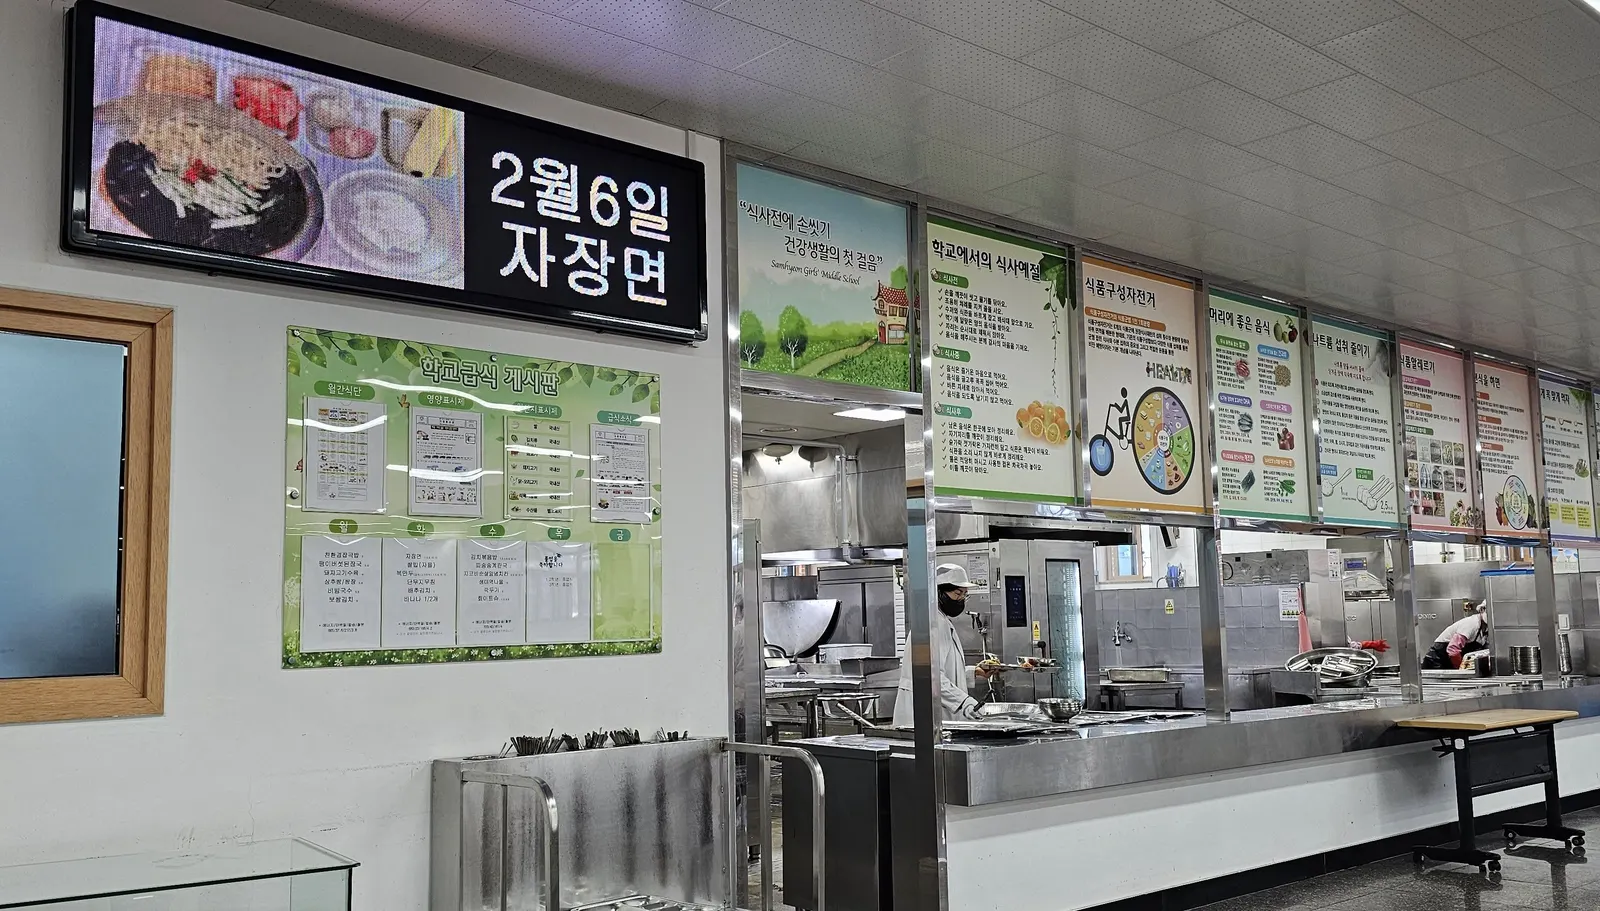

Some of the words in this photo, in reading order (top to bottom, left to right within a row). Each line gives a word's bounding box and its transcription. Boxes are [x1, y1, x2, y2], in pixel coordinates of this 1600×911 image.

[491, 151, 670, 242] 2월6일
[796, 217, 830, 239] 손씻기
[784, 236, 840, 263] 건강생활의
[843, 249, 853, 267] 첫
[932, 239, 992, 270] 학교에서의
[996, 256, 1040, 281] 식사예절
[500, 222, 667, 306] 자장면
[771, 260, 802, 274] Samhyeon
[821, 271, 841, 281] Middle
[843, 275, 860, 285] School
[944, 289, 954, 297] 손을
[955, 291, 968, 301] 깨끗이
[1085, 277, 1156, 308] 식품구성자전거
[1209, 308, 1234, 327] 머리에
[1236, 314, 1252, 331] 좋은
[1255, 319, 1270, 335] 음식
[1312, 333, 1333, 350] 나트륨
[1335, 339, 1348, 353] 섭취
[1351, 342, 1370, 358] 줄이기
[945, 349, 960, 360] 식사중
[422, 356, 498, 389] 학교급식
[504, 366, 559, 396] 게시판
[1490, 375, 1500, 388] 하면
[328, 383, 361, 396] 월간식단
[608, 413, 632, 424] 급식소식
[340, 520, 348, 533] 월
[416, 524, 426, 534] 화
[489, 527, 496, 536] 수
[555, 528, 563, 539] 목
[617, 530, 623, 541] 금
